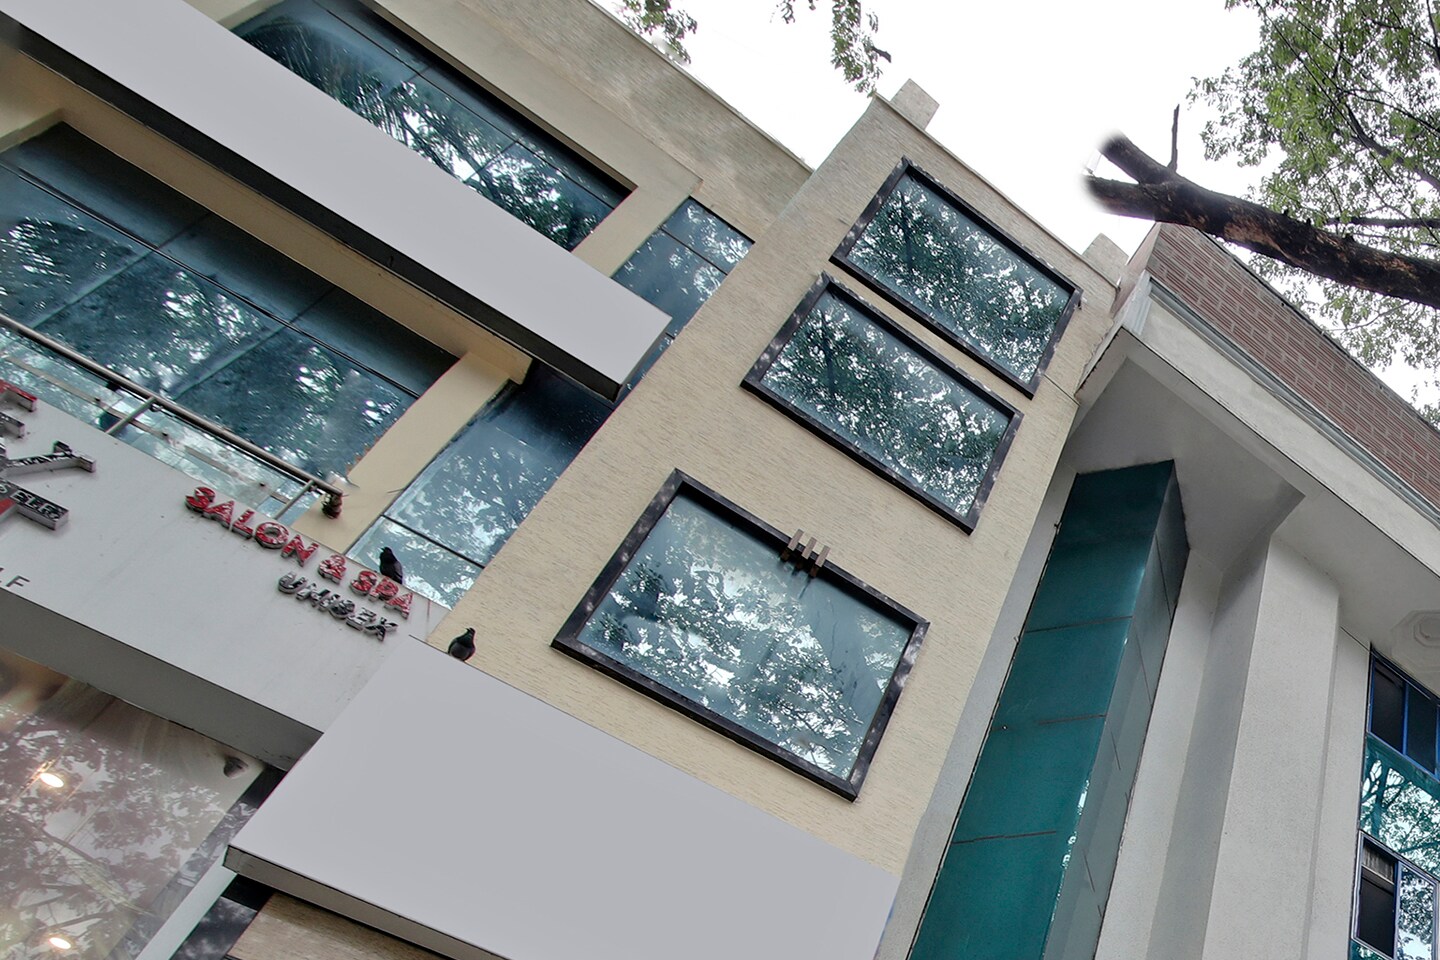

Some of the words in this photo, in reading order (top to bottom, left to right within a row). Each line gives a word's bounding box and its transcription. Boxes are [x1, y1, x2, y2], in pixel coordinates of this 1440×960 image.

[185, 487, 319, 567] SALON
[318, 555, 347, 585] &
[350, 570, 413, 619] SPA
[278, 571, 398, 641] UNISEX
